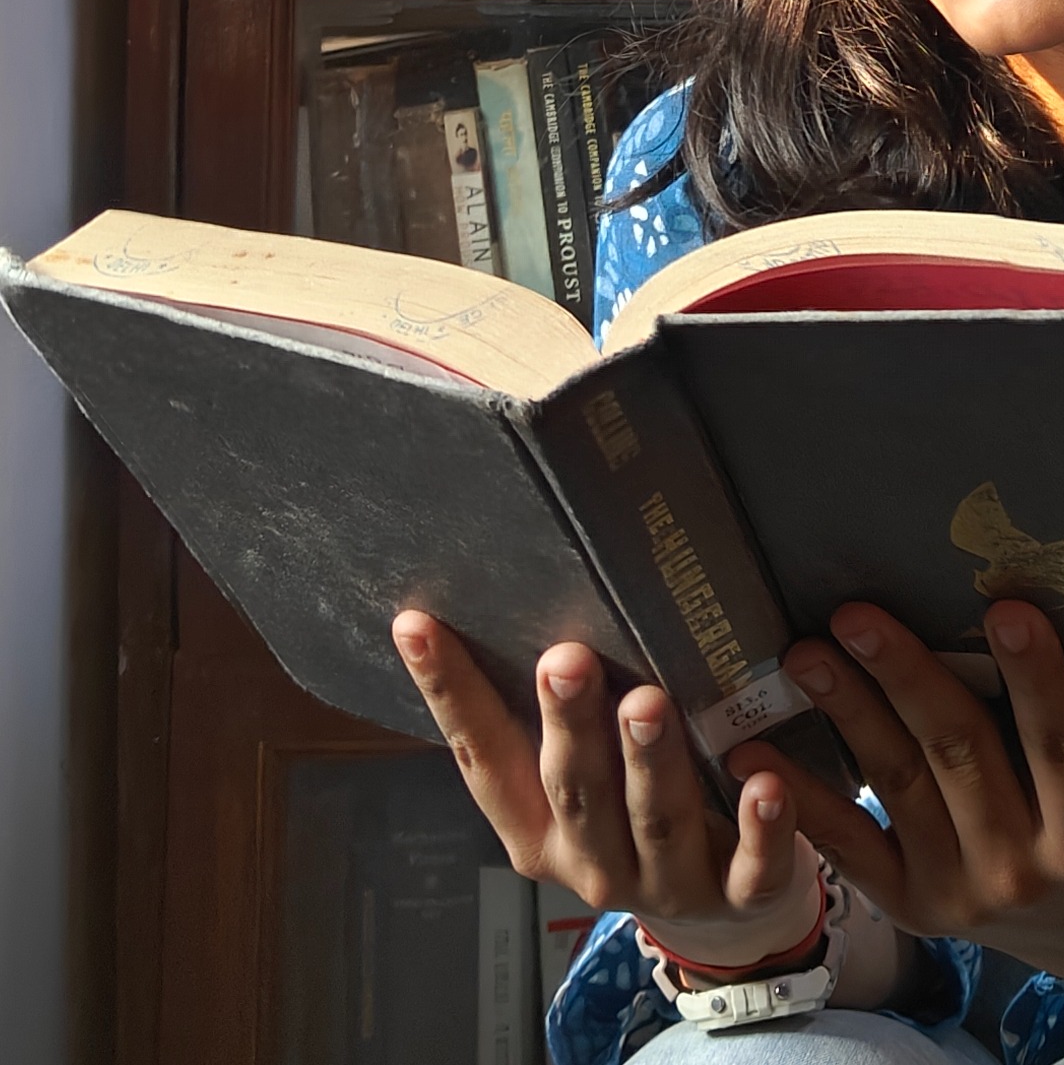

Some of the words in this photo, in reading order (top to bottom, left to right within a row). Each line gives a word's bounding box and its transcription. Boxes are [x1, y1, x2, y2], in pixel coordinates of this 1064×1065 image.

[541, 73, 553, 91] THE
[544, 93, 560, 144] CAMBRIDGE
[580, 85, 597, 135] CAMBRIDGE
[549, 146, 566, 199] COMPANION
[585, 138, 602, 191] COMPANION
[465, 186, 492, 263] ALAIN
[556, 200, 567, 214] TO
[557, 217, 582, 304] PROUST
[639, 491, 674, 535] THE
[652, 528, 733, 653] HUNGER
[732, 701, 773, 727] COL
